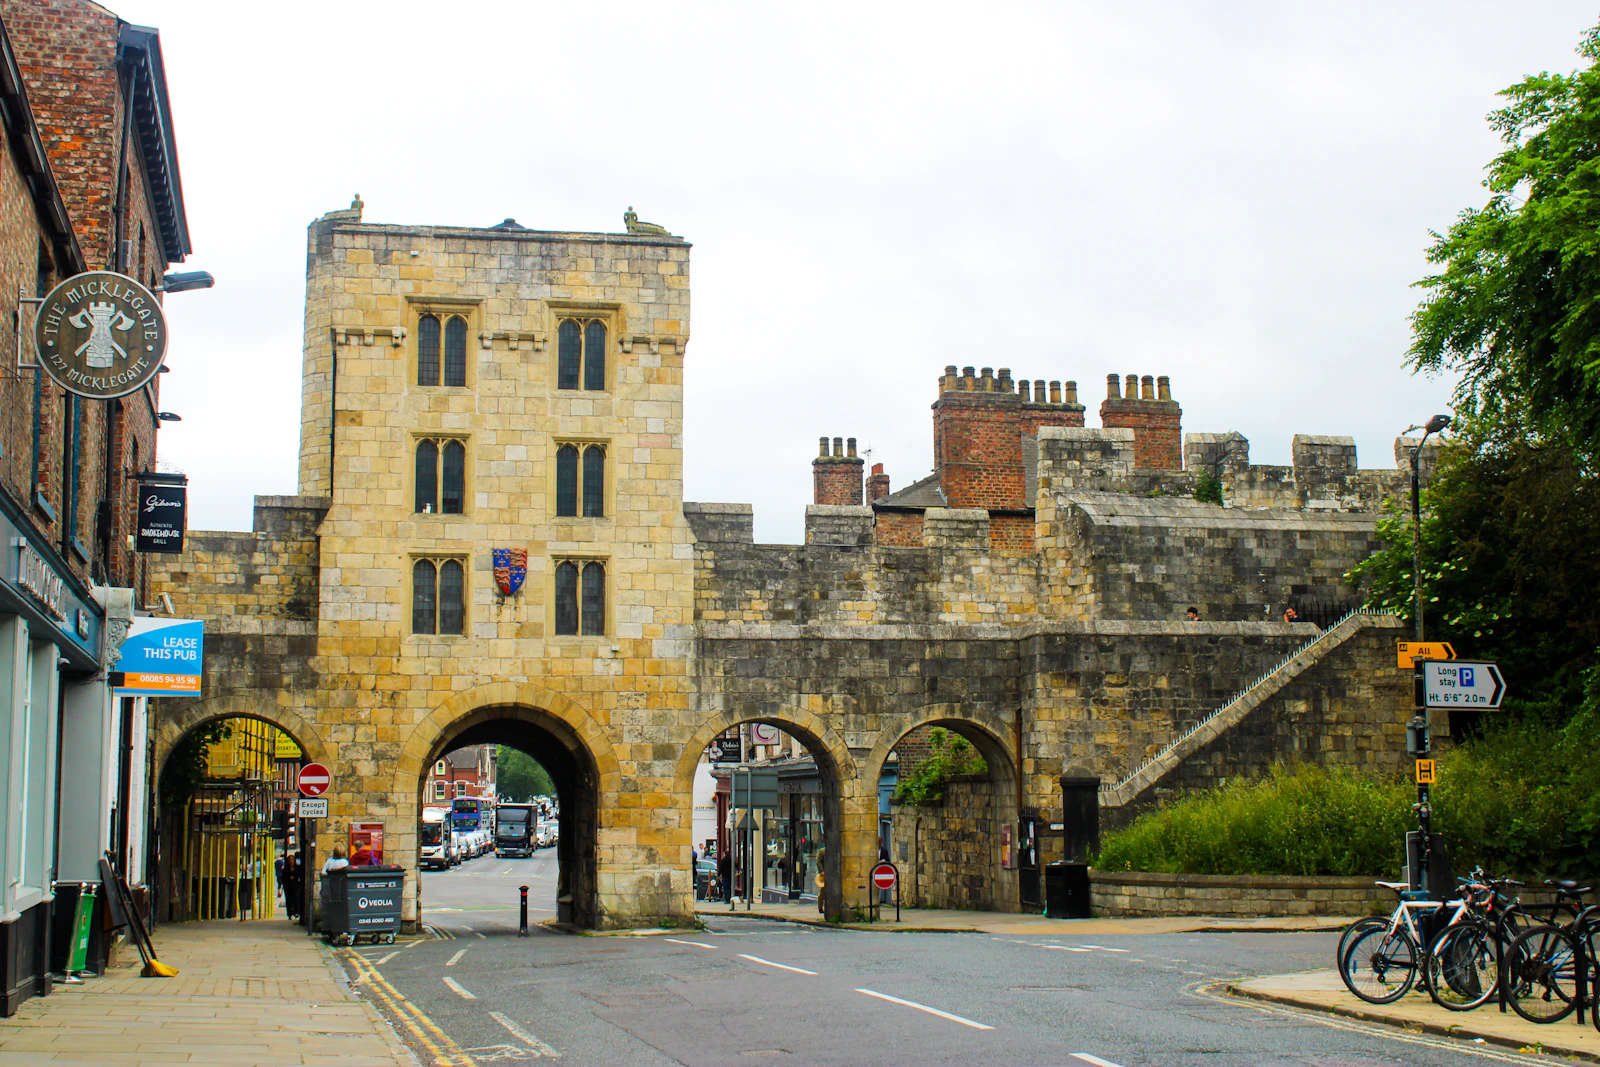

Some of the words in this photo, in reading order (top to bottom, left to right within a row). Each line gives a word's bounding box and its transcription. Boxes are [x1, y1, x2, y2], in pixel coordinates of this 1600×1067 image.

[43, 303, 67, 335] THE
[65, 281, 158, 340] MICKLEGATE
[50, 354, 69, 371] 127
[66, 357, 150, 391] MICKLEGATE
[141, 528, 180, 538] SMOKEHOUSE
[163, 636, 198, 649] LEASE
[143, 647, 172, 659] THIS
[173, 649, 197, 660] PUB
[1418, 647, 1431, 655] All
[1437, 666, 1457, 676] Long
[139, 674, 164, 683] 08085
[176, 676, 185, 684] 95
[1462, 669, 1472, 685] P
[1439, 678, 1456, 687] stay
[1429, 693, 1441, 702] Ht.
[301, 801, 325, 809] Except
[302, 808, 324, 816] cycles
[368, 899, 393, 907] VEOLIA
